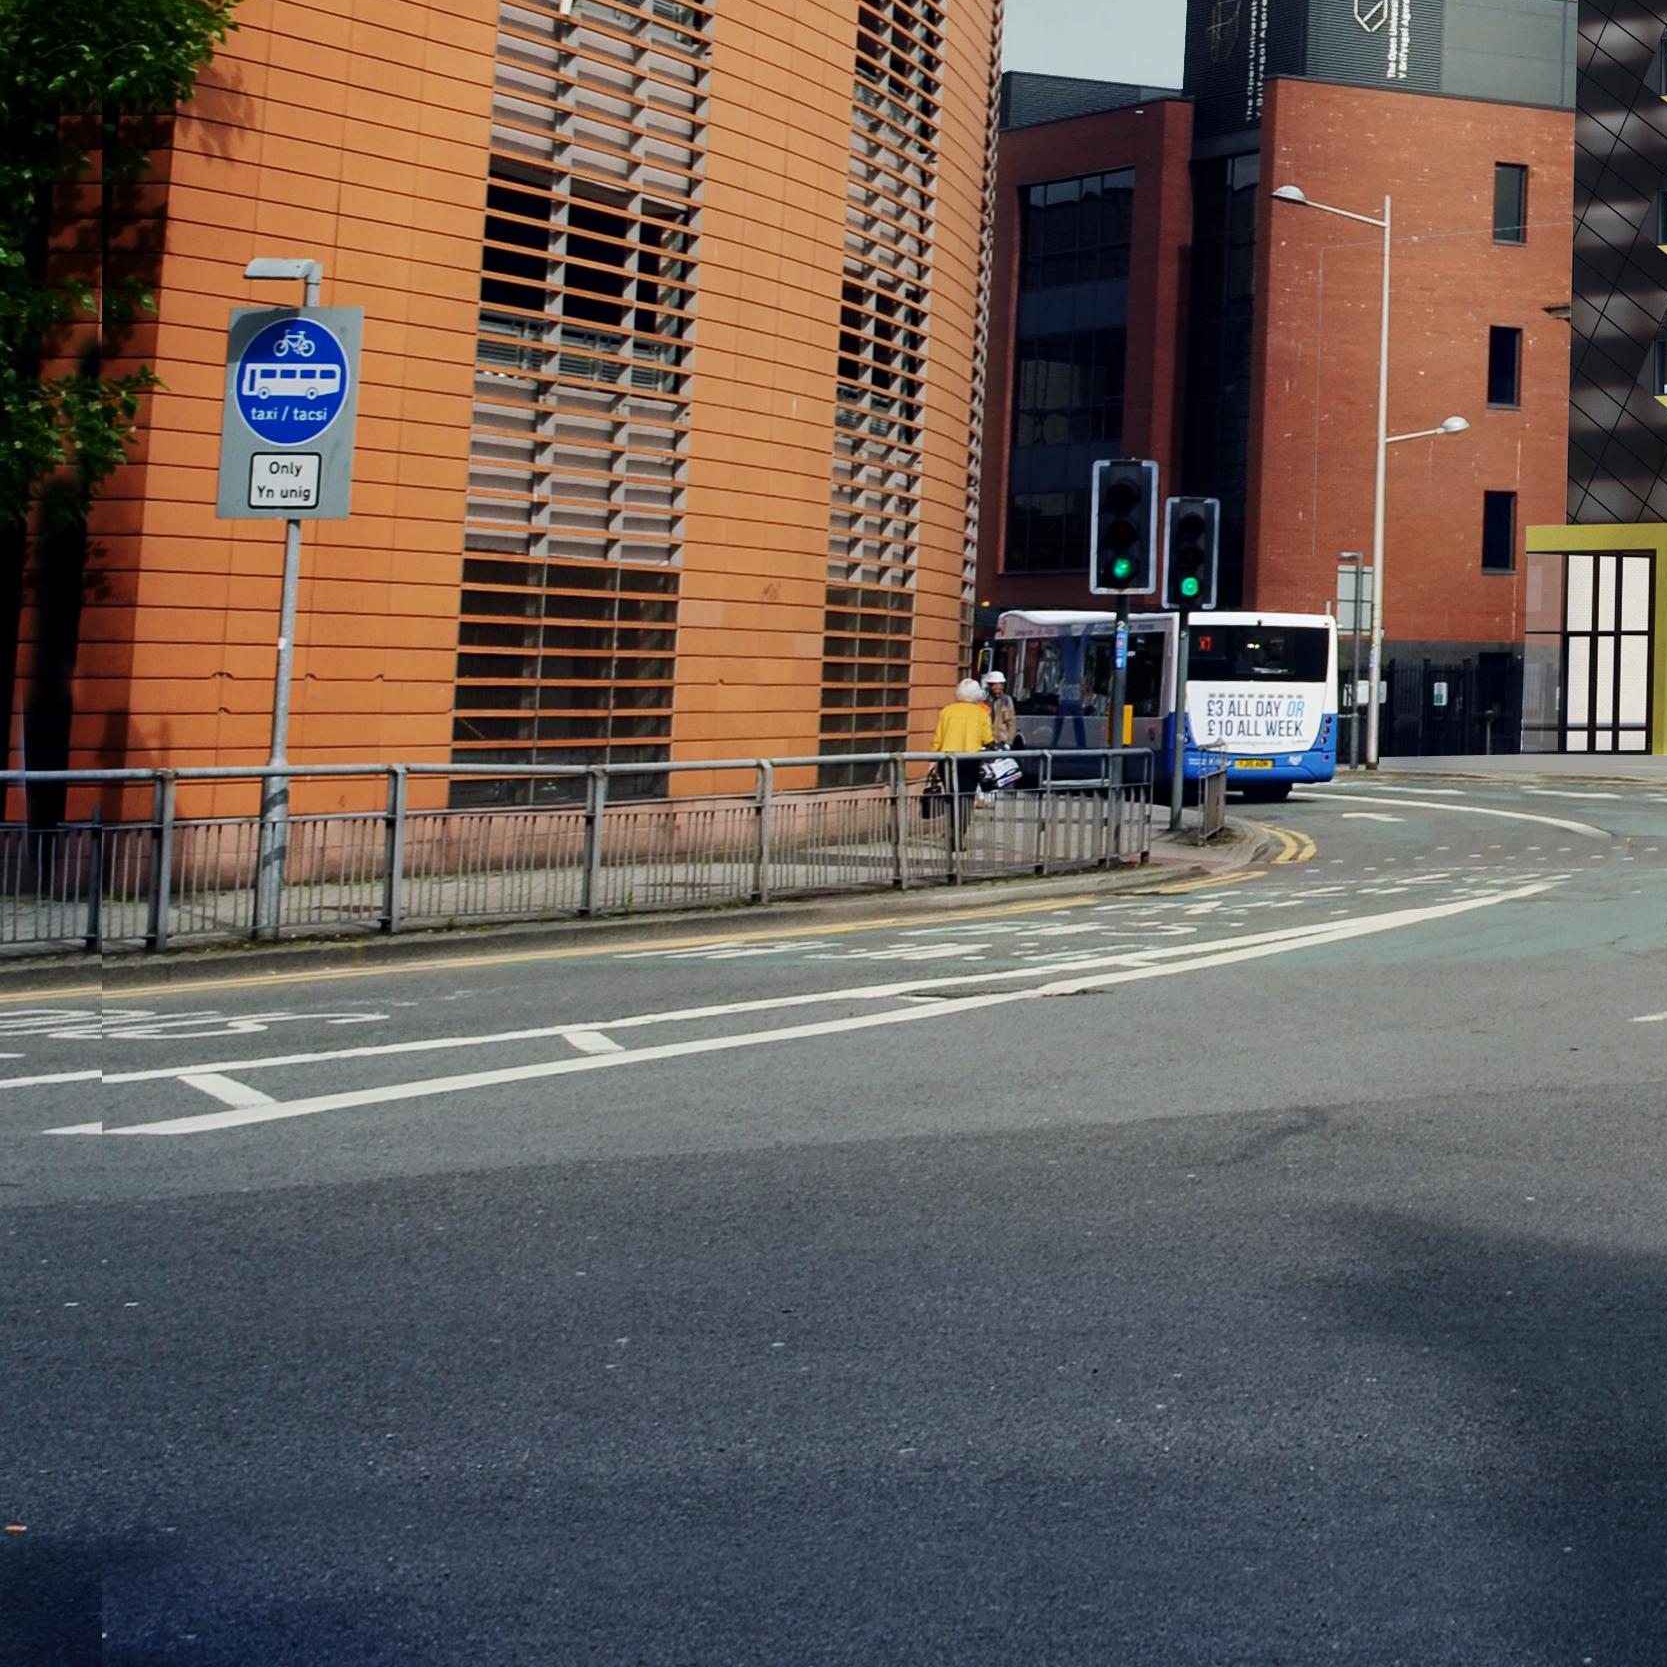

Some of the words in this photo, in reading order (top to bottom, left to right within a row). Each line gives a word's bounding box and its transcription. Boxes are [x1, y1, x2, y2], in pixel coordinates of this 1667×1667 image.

[1247, 61, 1256, 96] Open
[251, 407, 278, 420] taxi
[293, 407, 327, 421] tacsi
[269, 461, 303, 477] Only
[257, 485, 275, 498] Yn
[280, 485, 311, 501] unig
[1117, 620, 1126, 631] 2
[1206, 700, 1224, 717] £3
[1228, 700, 1251, 717] ALL
[1255, 700, 1281, 717] DAY
[1287, 700, 1305, 717] OR
[1207, 719, 1233, 736] £10
[1237, 720, 1261, 736] ALL
[1266, 720, 1303, 736] WEEK
